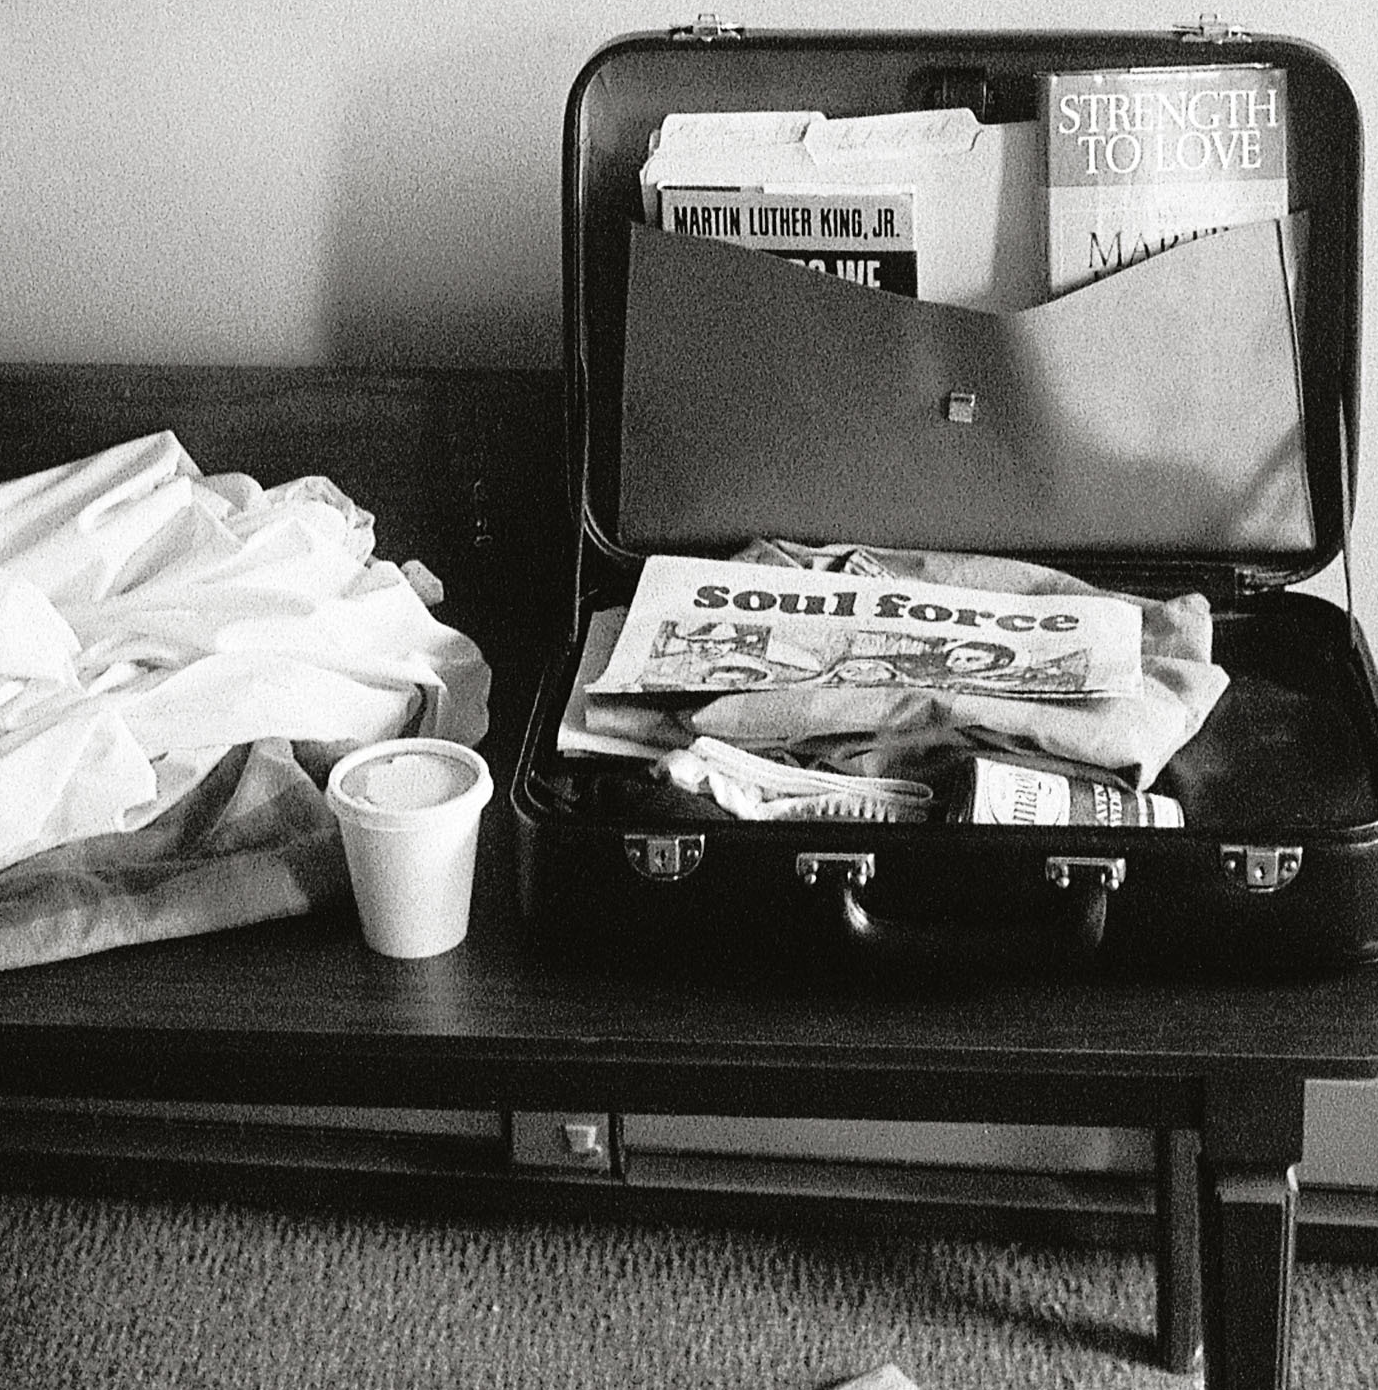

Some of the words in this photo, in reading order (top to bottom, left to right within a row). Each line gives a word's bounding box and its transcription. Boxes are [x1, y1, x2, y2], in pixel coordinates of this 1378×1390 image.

[1058, 89, 1278, 134] STRENGTH
[1077, 133, 1141, 174] TO
[1155, 130, 1262, 172] LOVE
[673, 206, 741, 236] MARTIN
[749, 207, 812, 237] LUTHER
[820, 207, 869, 240] KING,
[872, 207, 901, 239] JR.
[692, 584, 857, 616] soul
[873, 593, 1081, 634] force
